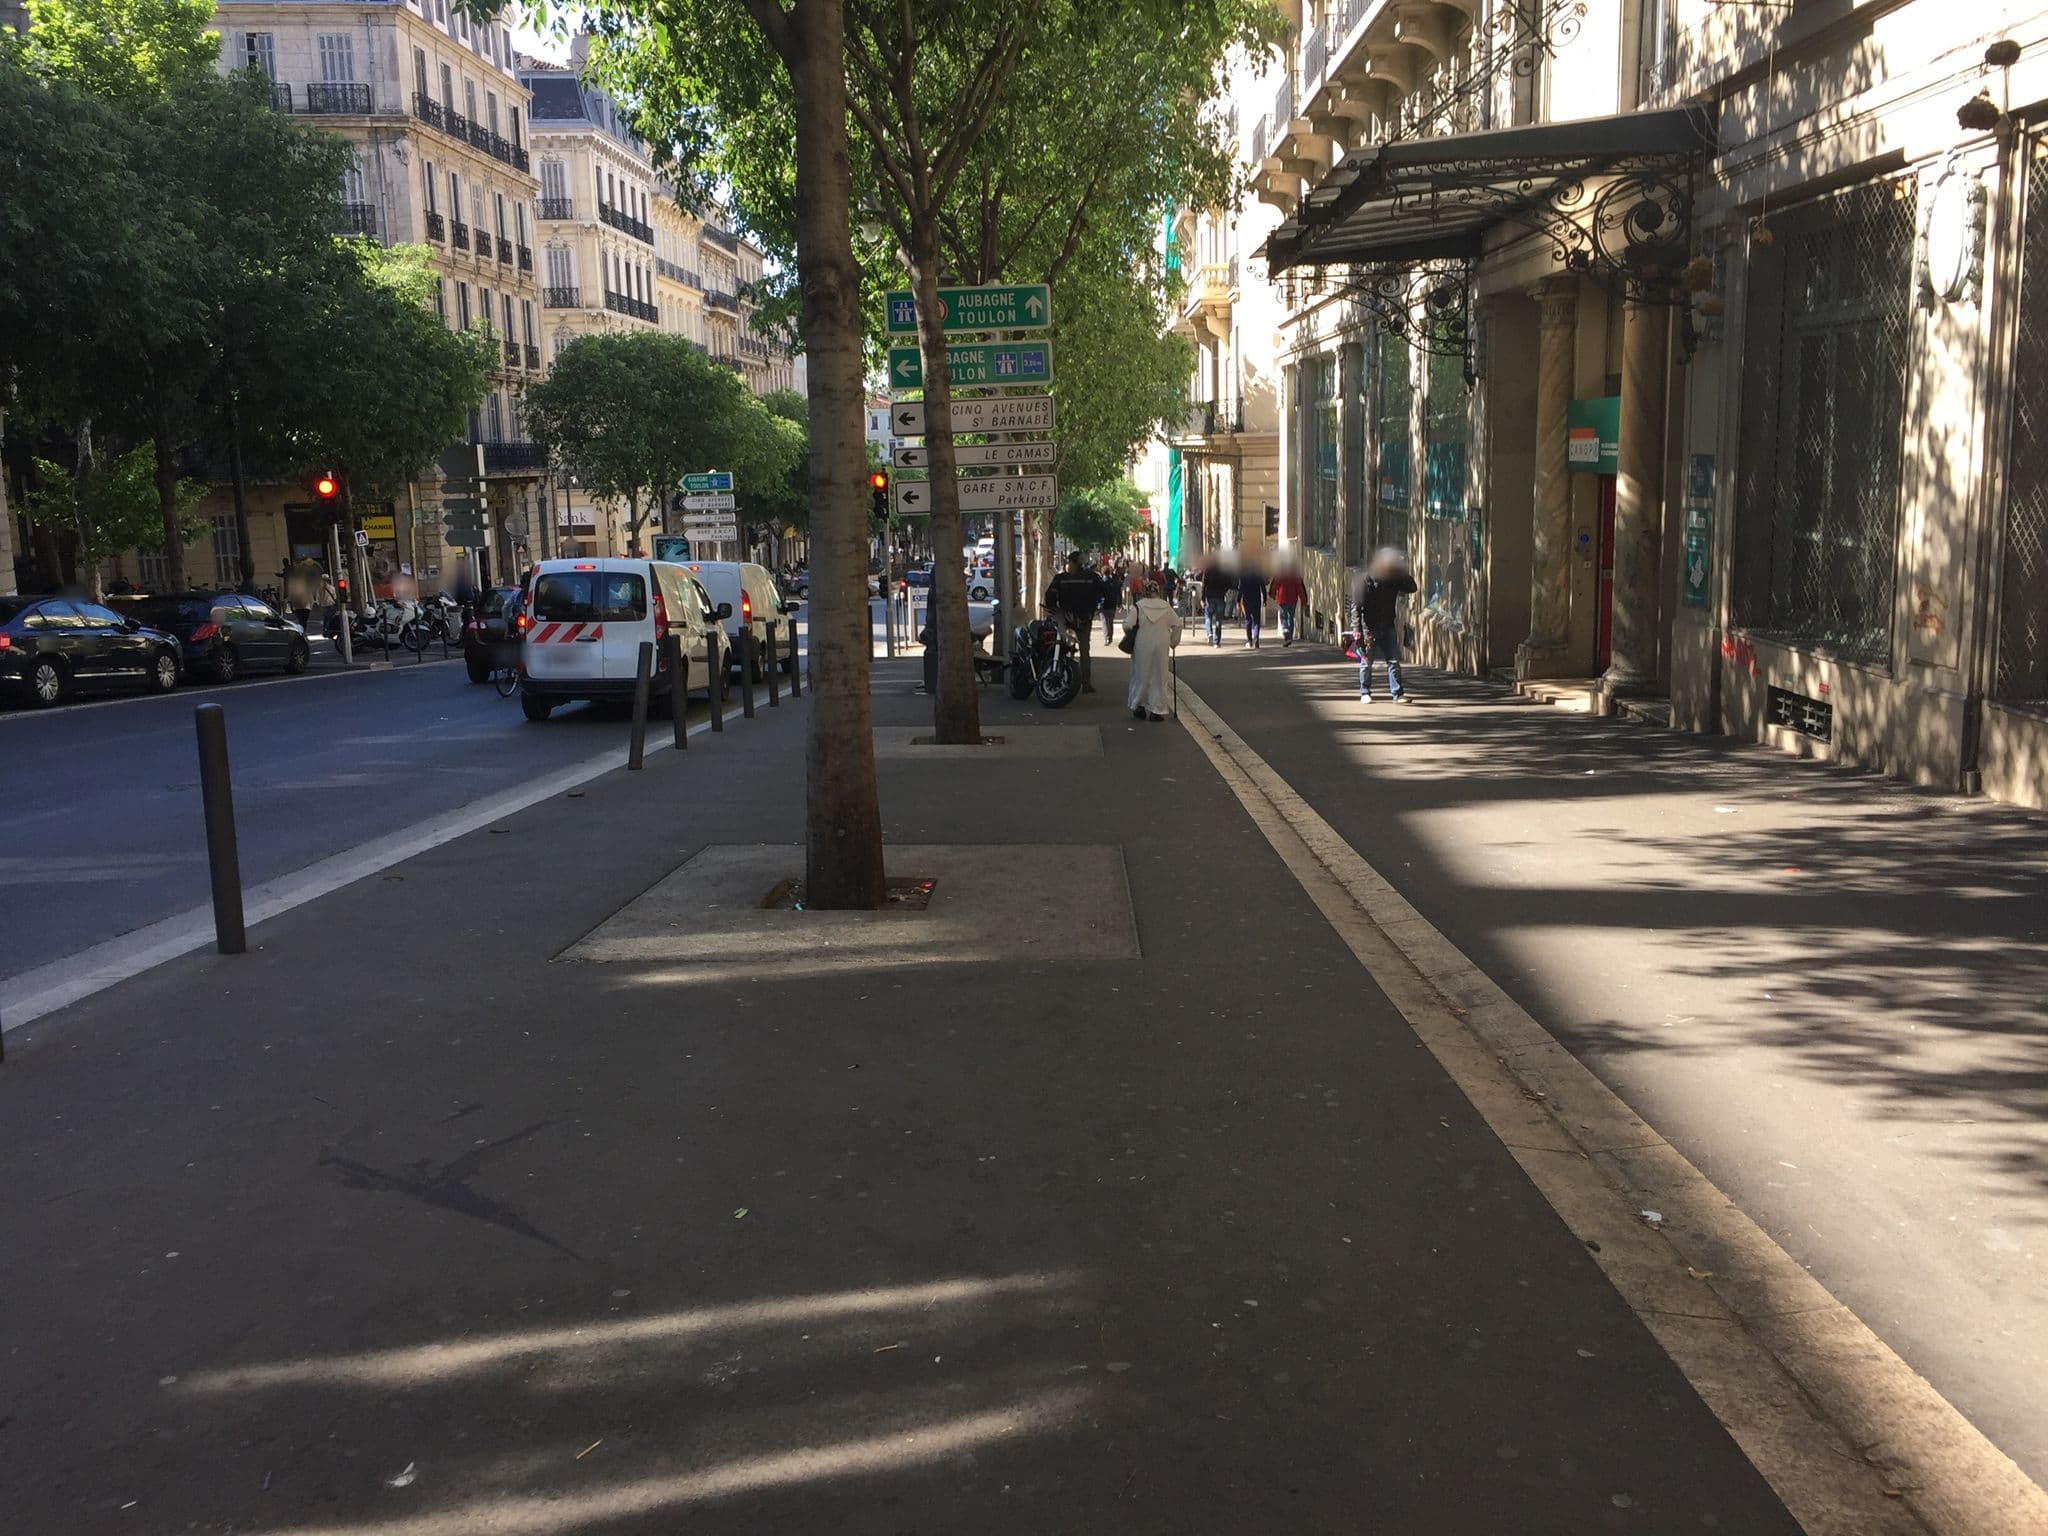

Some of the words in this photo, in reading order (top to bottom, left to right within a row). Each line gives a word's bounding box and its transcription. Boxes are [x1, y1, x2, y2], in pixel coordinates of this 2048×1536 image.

[958, 293, 1015, 308] AUBAGNE
[958, 309, 1016, 325] TOULON
[945, 351, 985, 364] BAGNE
[952, 404, 982, 416] CINQ
[992, 402, 1049, 413] AVENUES
[992, 413, 1049, 426] BARNABÉ
[985, 450, 998, 460] LE
[1007, 448, 1050, 459] CAMAS
[963, 483, 995, 494] GARE
[1005, 480, 1051, 492] S.N.C.F.
[998, 495, 1052, 505] Parkings
